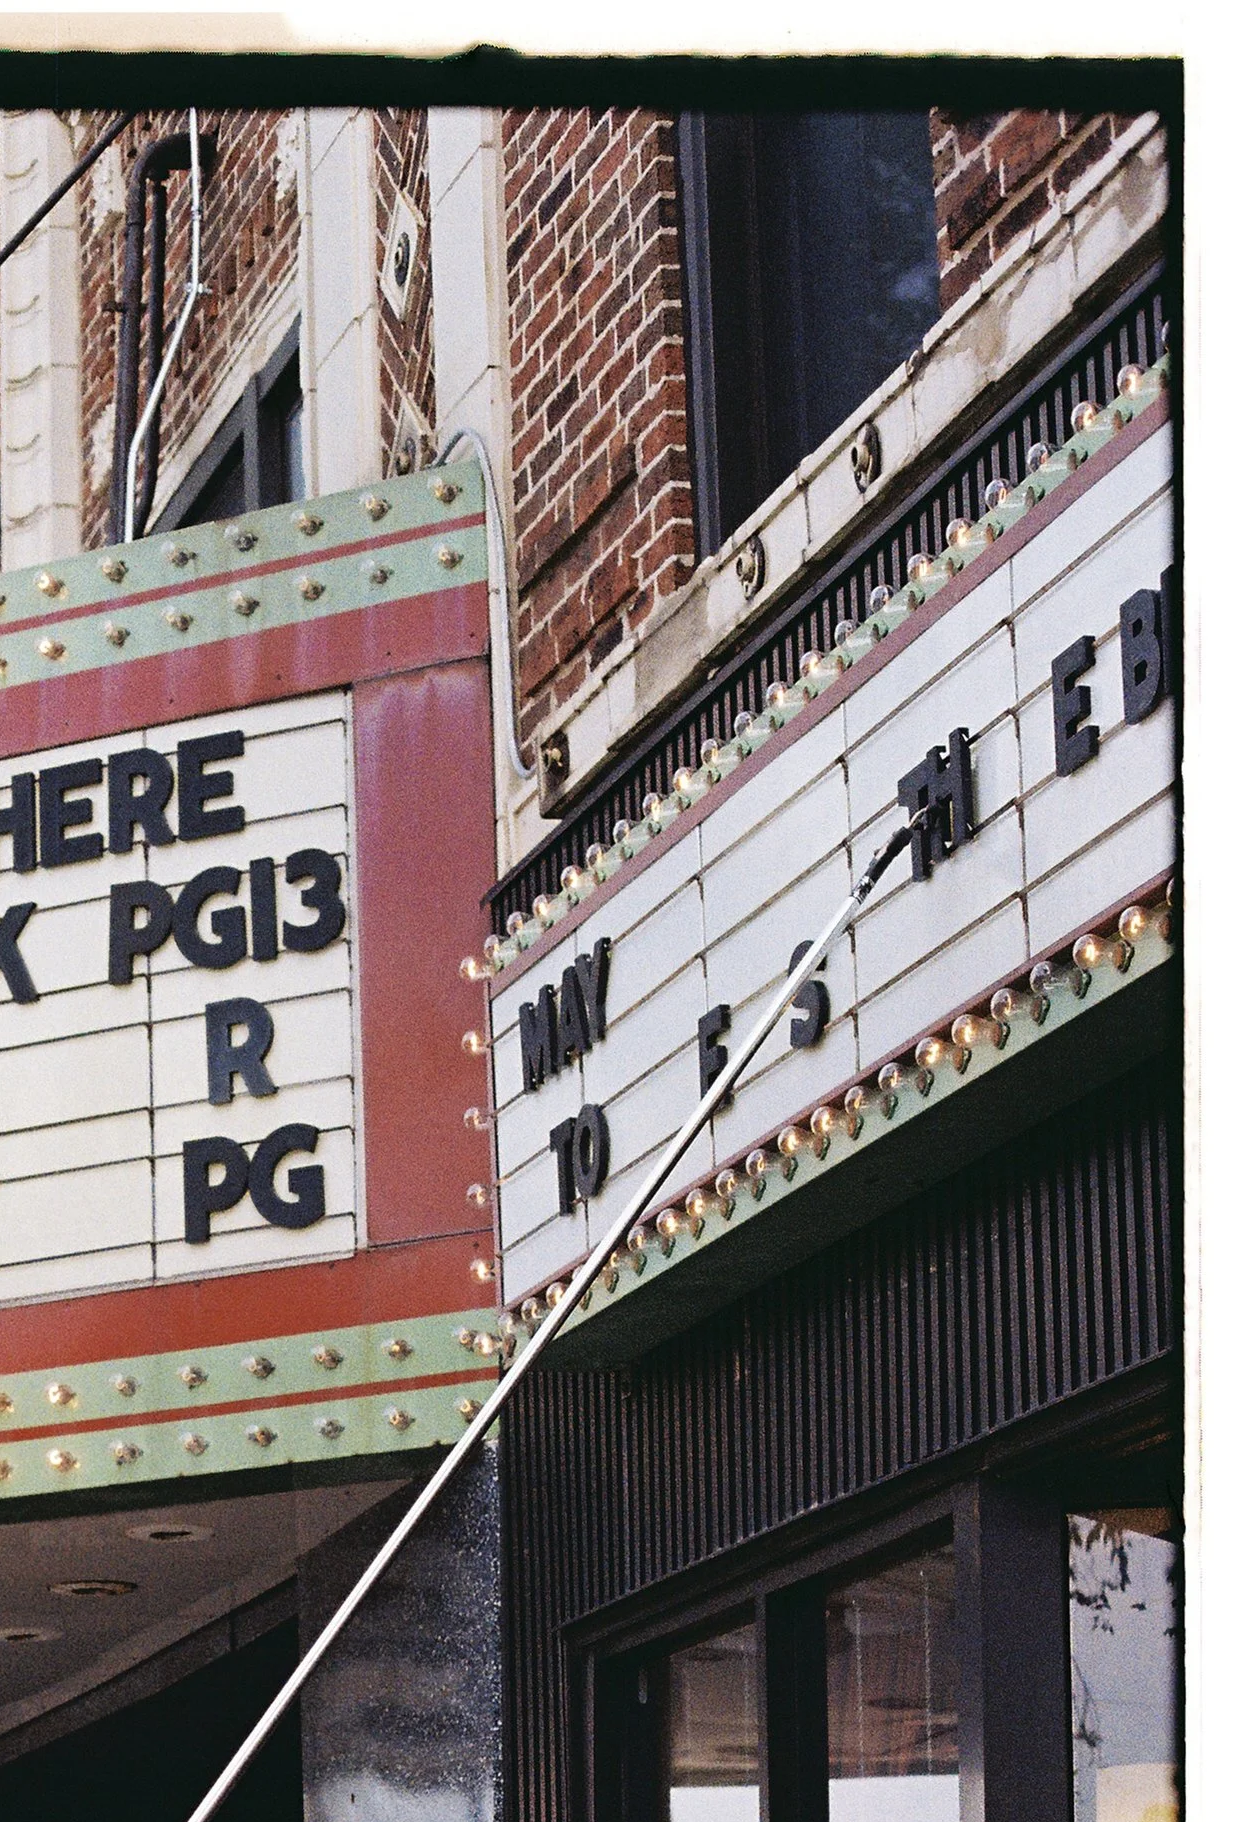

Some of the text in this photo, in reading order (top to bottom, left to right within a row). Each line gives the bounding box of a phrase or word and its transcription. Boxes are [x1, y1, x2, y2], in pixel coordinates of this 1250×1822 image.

[519, 937, 612, 1092] MAY
[1120, 564, 1175, 726] B
[205, 997, 278, 1105] R
[182, 1123, 327, 1245] PG
[550, 1103, 612, 1217] TO
